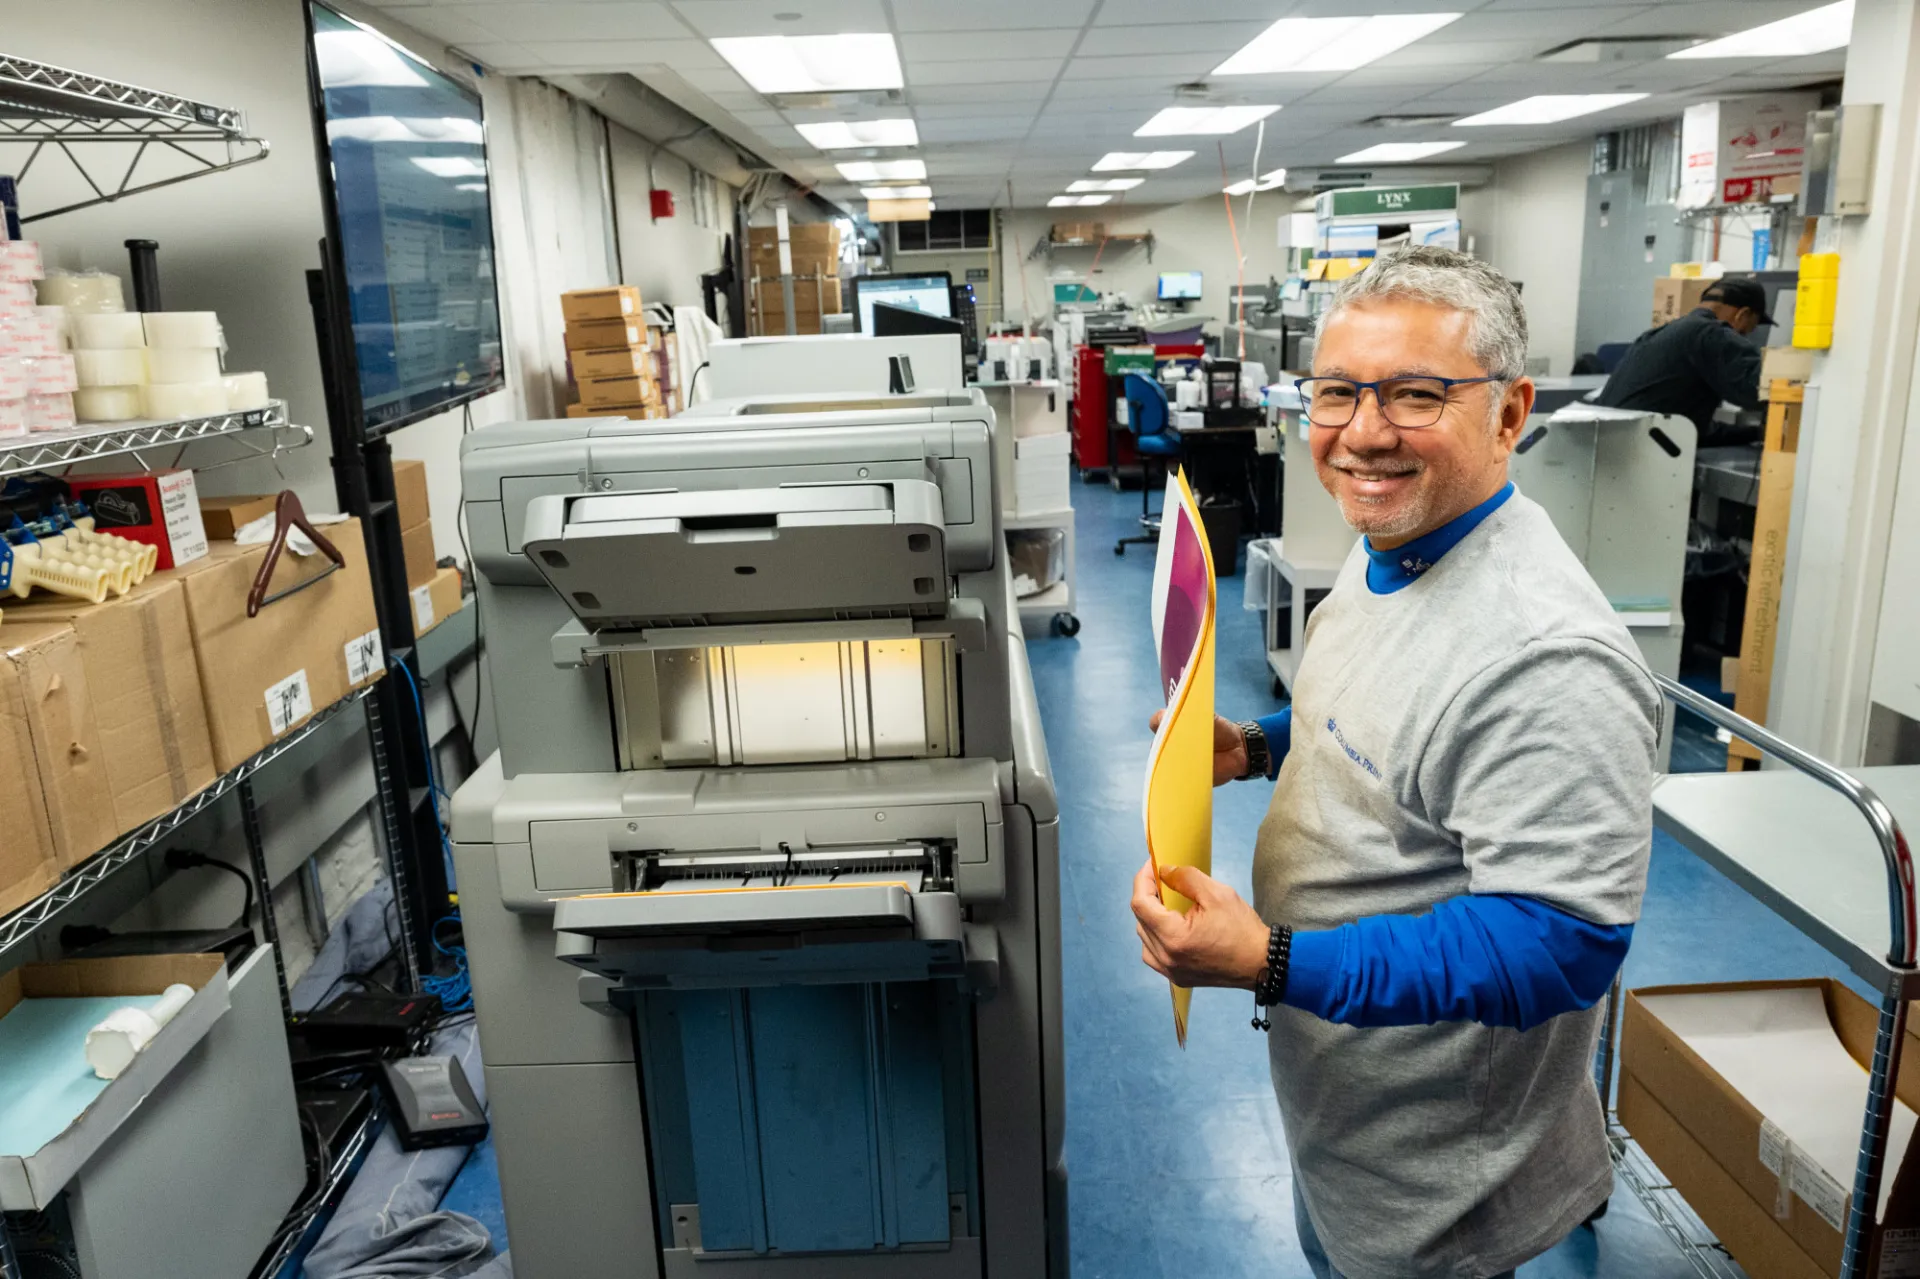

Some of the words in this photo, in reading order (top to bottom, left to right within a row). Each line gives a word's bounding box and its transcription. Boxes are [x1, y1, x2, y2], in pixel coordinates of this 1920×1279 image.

[1377, 192, 1412, 204] LYNX
[1761, 529, 1778, 578] exotic
[1749, 580, 1772, 674] refreshment
